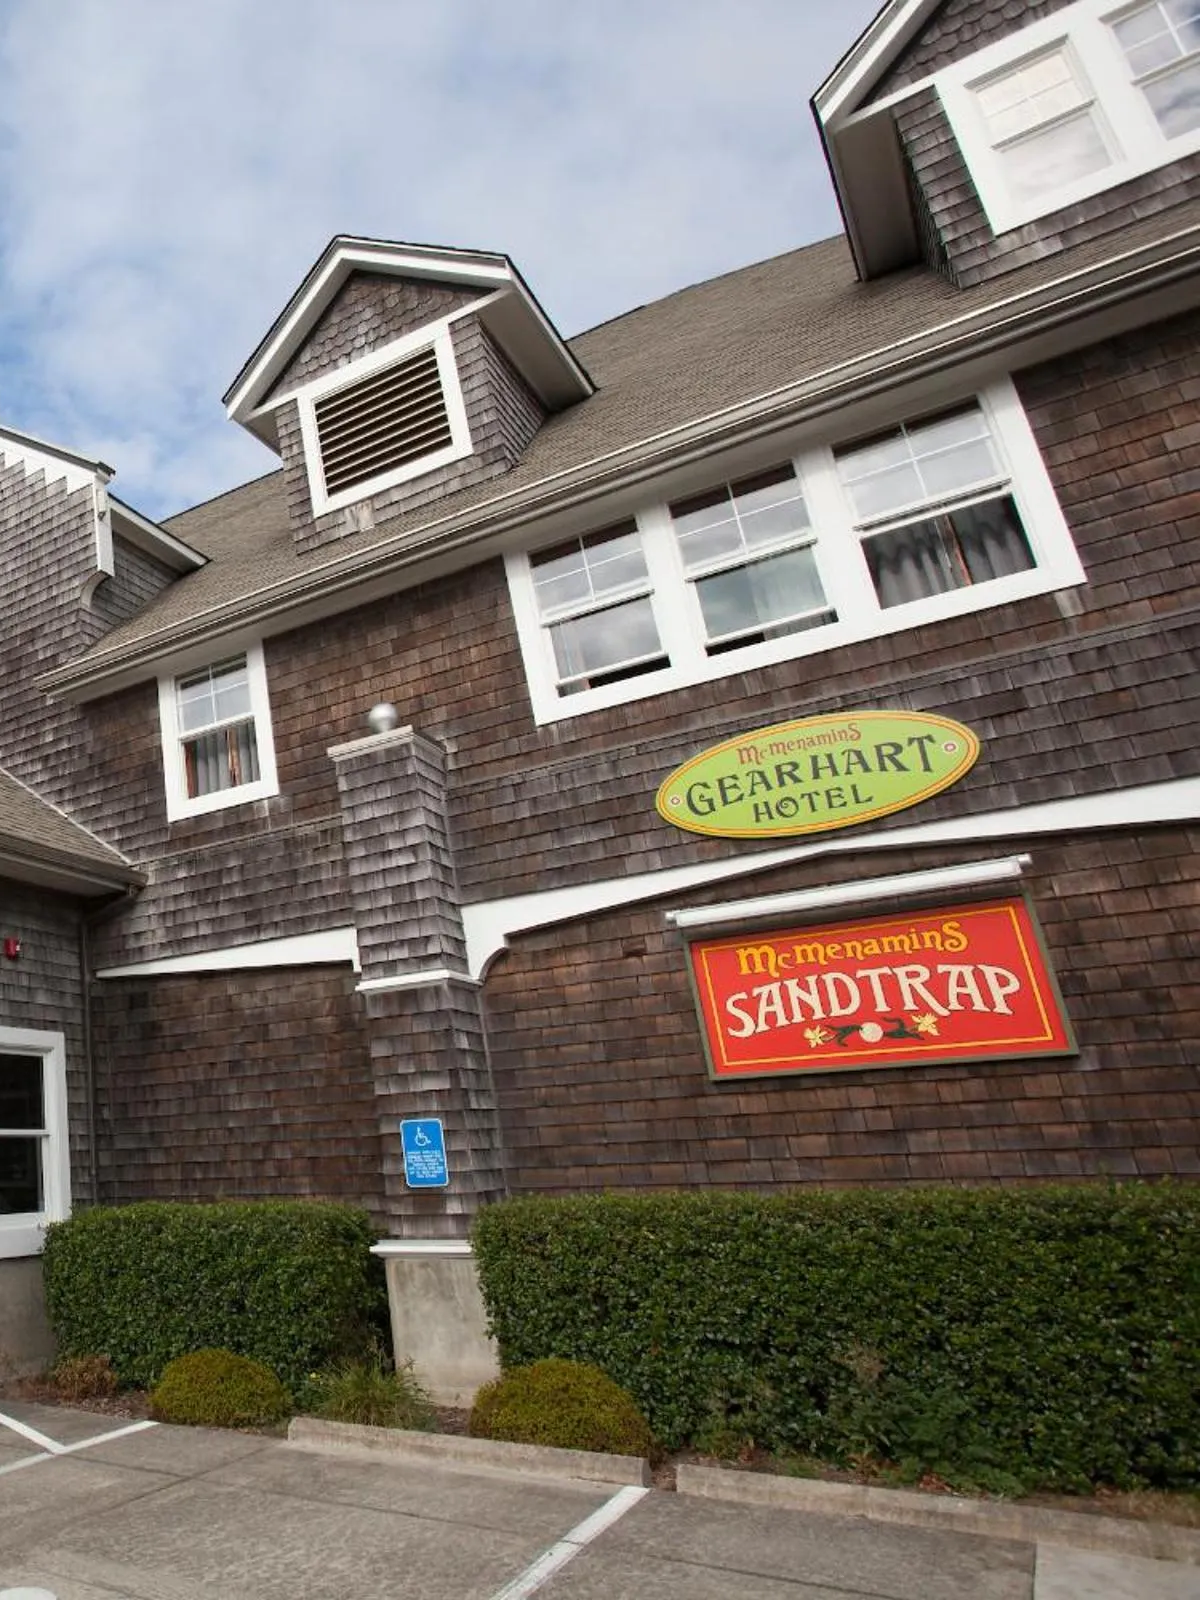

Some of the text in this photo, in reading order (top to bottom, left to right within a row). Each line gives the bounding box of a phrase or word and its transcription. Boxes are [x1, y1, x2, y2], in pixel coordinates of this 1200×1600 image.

[685, 734, 937, 816] GEARHART
[752, 783, 875, 823] HOTEL
[724, 963, 1021, 1039] SANDTRAP
